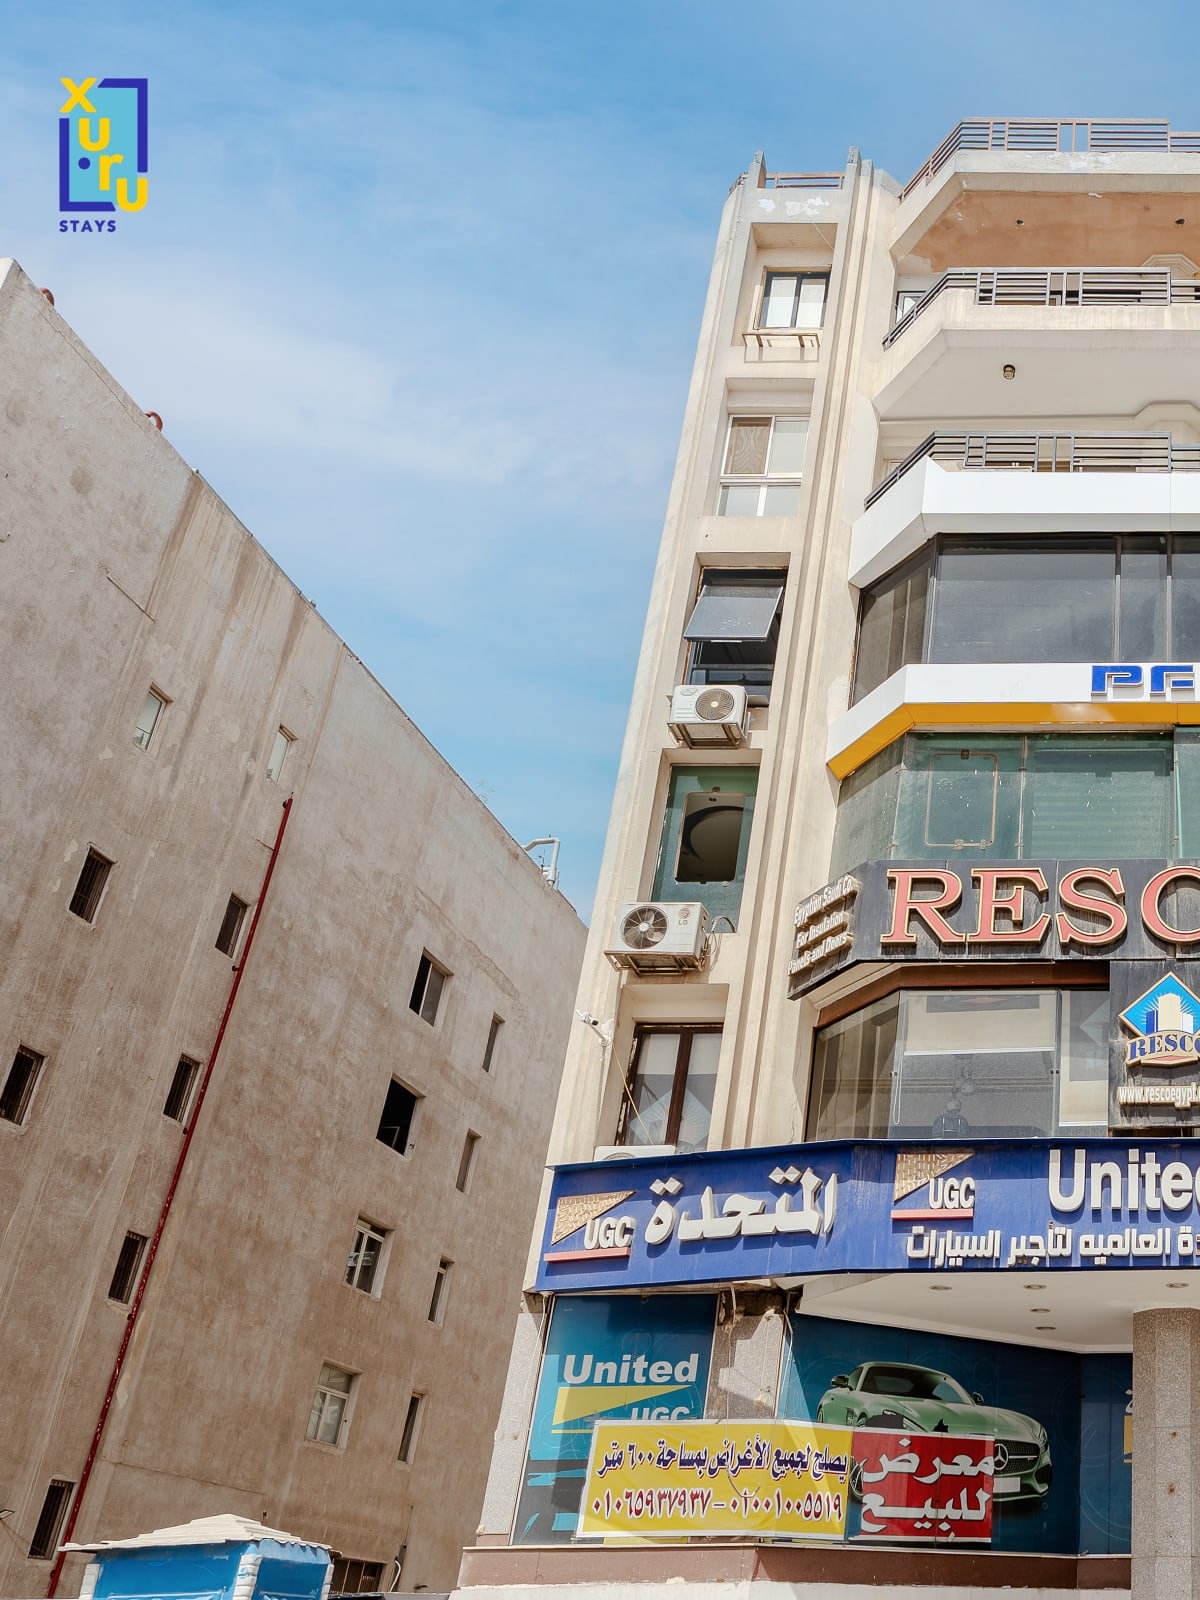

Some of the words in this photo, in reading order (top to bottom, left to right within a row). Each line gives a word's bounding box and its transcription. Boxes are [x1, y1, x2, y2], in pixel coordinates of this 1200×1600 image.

[823, 878, 842, 906] Saudi
[797, 932, 809, 949] For
[809, 912, 843, 941] Insulation
[788, 951, 811, 975] Panels
[826, 932, 847, 954] Doors
[644, 1165, 839, 1245] المتحدة
[929, 1177, 976, 1210] UGC
[584, 1216, 635, 1250] UGC
[907, 1225, 1000, 1267] السيارات
[563, 1353, 699, 1384] United
[596, 1440, 624, 1477] متر
[628, 1443, 654, 1469] ٦٠٠
[656, 1438, 709, 1478] بمساحة
[708, 1433, 771, 1478] الأغراض
[771, 1442, 811, 1480] لجميع
[811, 1445, 848, 1484] يصلح
[862, 1437, 994, 1484] معرض
[861, 1487, 991, 1533] للبيع
